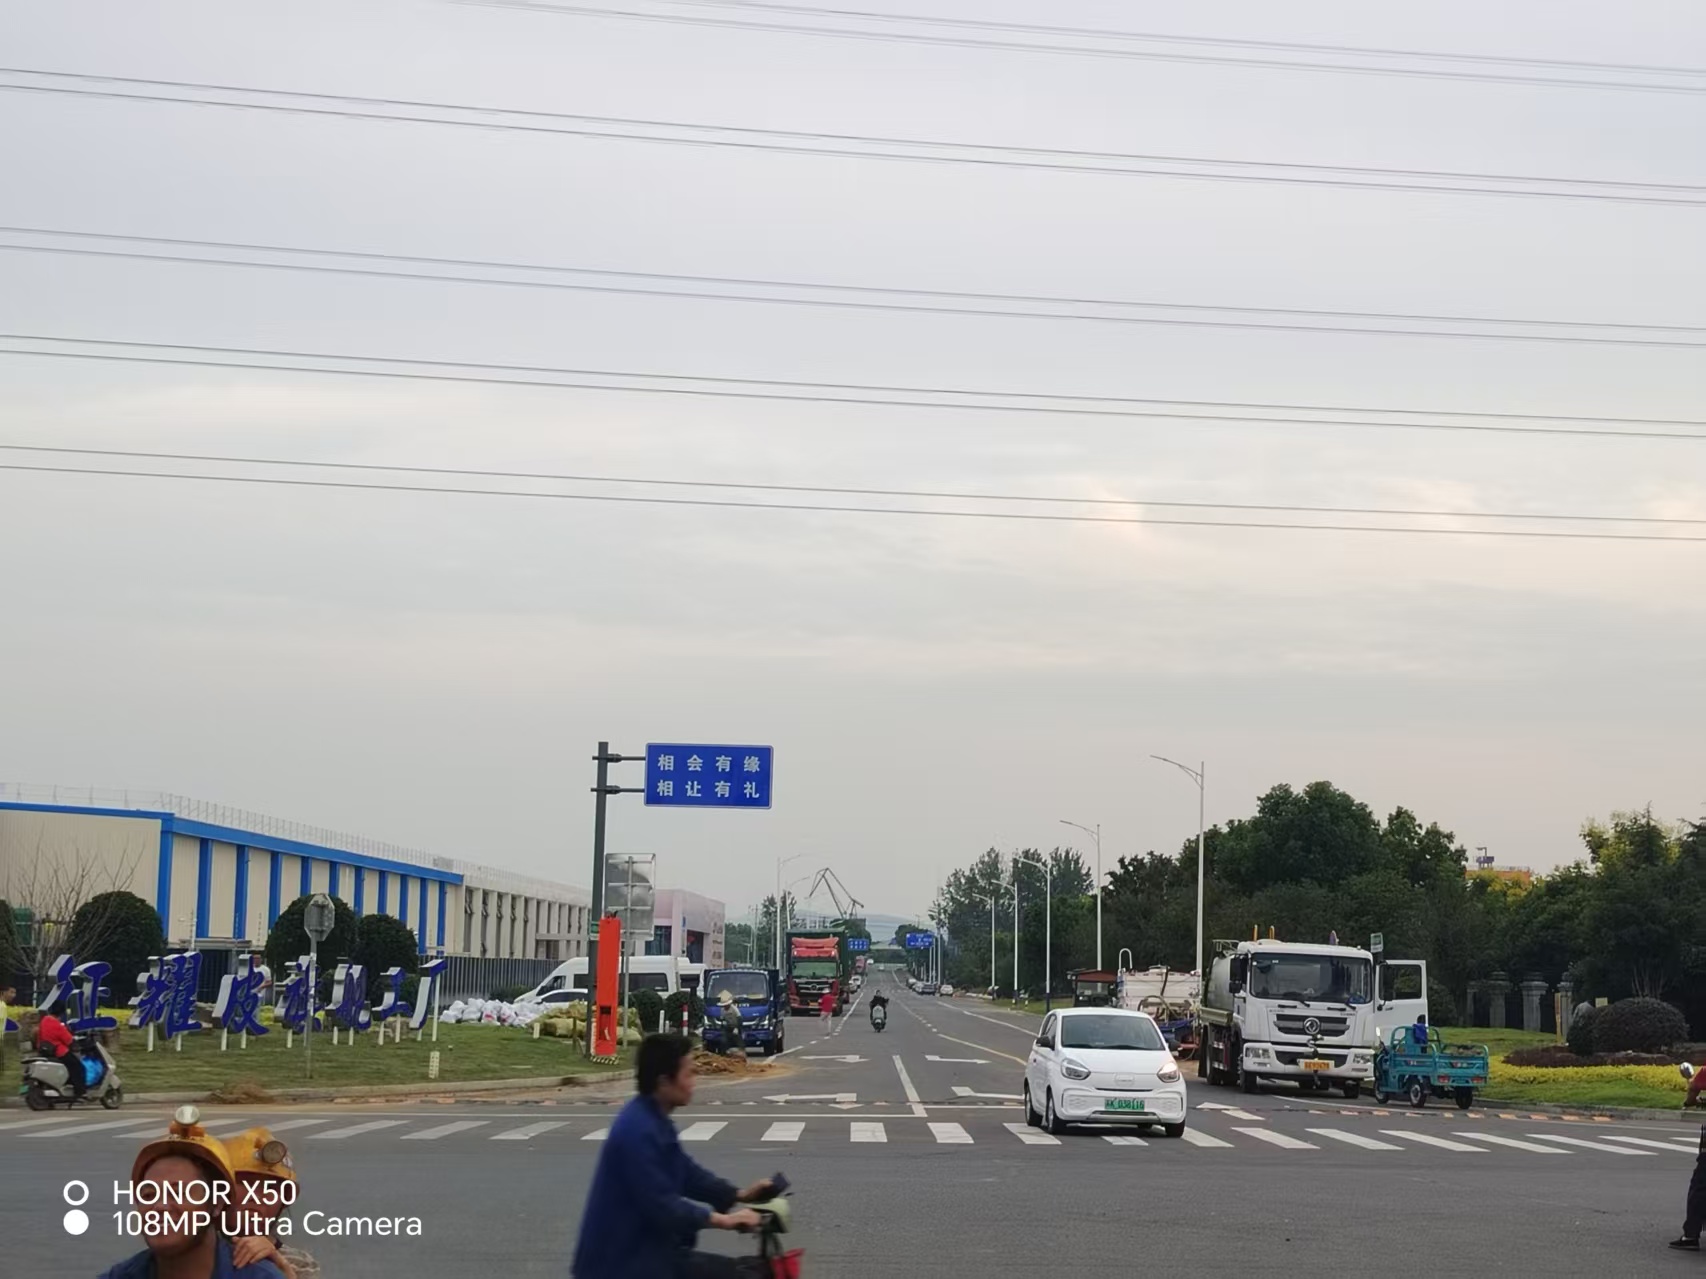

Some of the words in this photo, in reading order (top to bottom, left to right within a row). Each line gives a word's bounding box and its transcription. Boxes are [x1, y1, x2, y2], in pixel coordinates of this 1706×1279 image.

[658, 754, 761, 773] 相会有缘
[656, 779, 760, 799] 相让有礼
